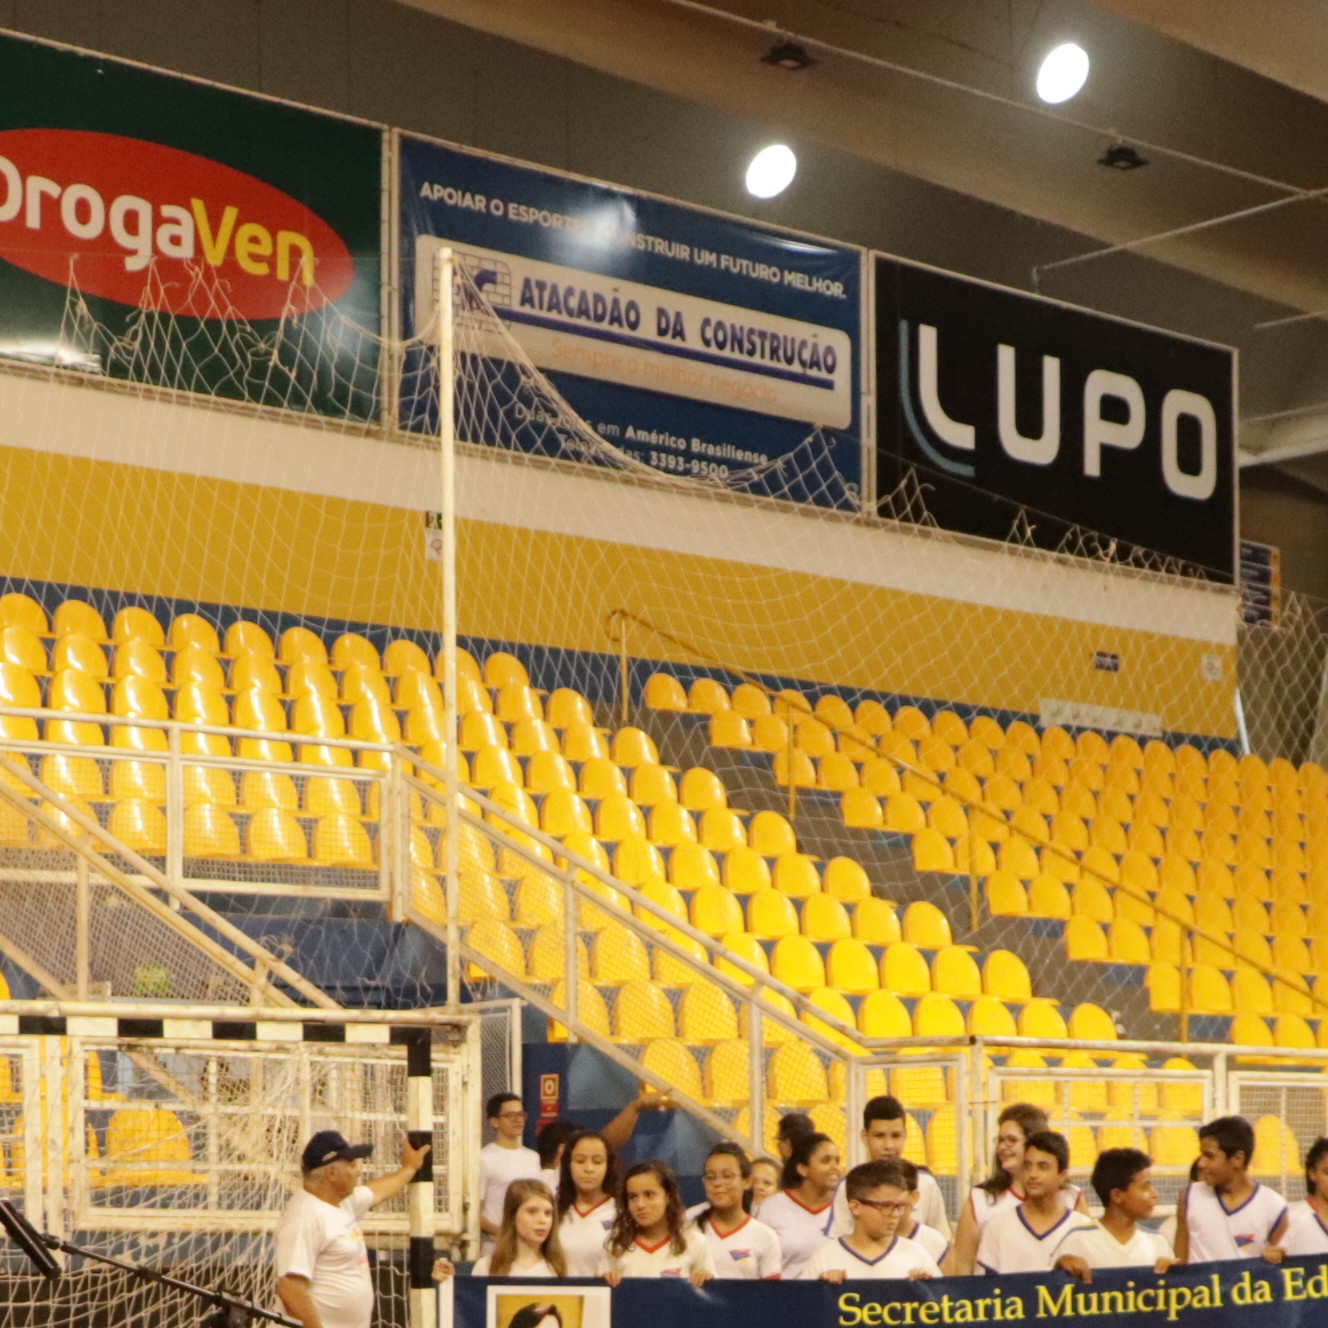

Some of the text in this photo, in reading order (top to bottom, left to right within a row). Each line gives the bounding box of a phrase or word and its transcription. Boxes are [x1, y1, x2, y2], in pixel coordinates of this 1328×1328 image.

[420, 181, 486, 212] APOIAR
[490, 200, 504, 216] O
[694, 247, 718, 269] UM
[720, 254, 781, 283] FUTURO
[783, 271, 847, 299] MELHOR.
[519, 277, 837, 376] ATACADÃO DA CONSTRUÇÃO
[596, 422, 621, 436] em
[625, 424, 687, 450] Américo
[690, 437, 768, 465] Brasiliense
[918, 323, 1218, 500] LUPO
[650, 450, 729, 479] 3393-9500
[838, 1288, 1025, 1326] Secretaria
[1036, 1273, 1223, 1321] Municipal
[1230, 1271, 1273, 1306] da
